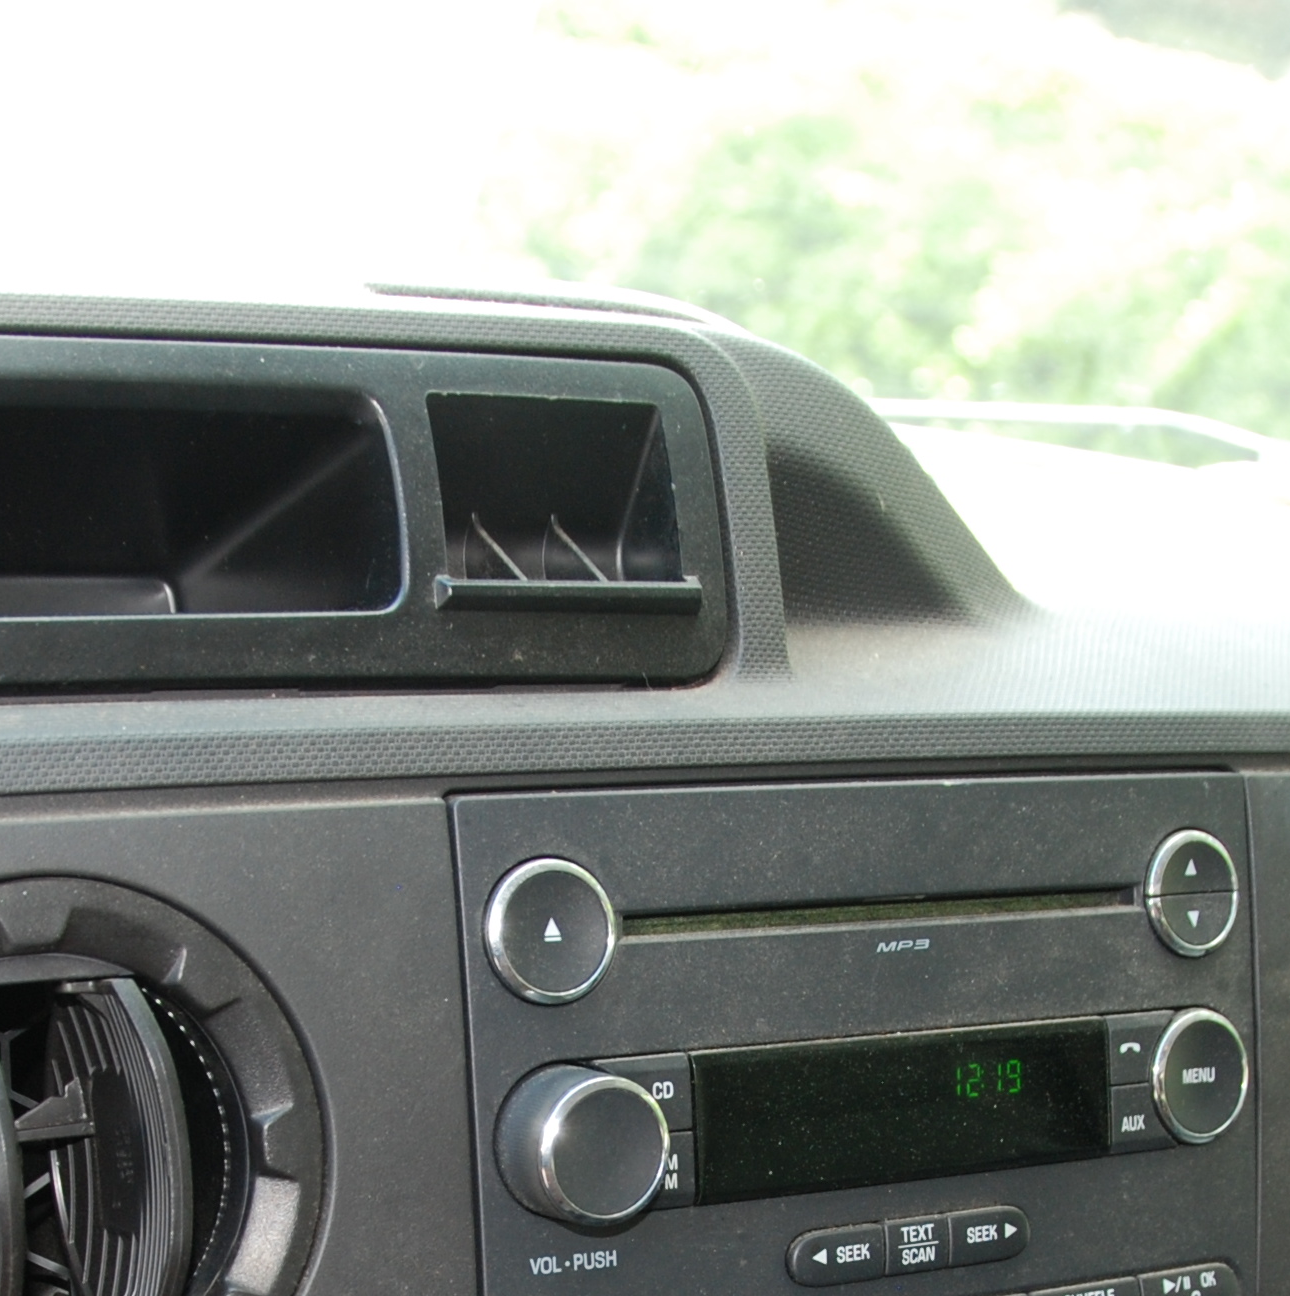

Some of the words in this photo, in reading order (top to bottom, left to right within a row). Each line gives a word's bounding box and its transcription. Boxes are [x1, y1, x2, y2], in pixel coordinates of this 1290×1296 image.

[876, 938, 931, 953] MP3
[1182, 1066, 1216, 1085] MENU
[652, 1081, 675, 1100] CD
[1121, 1114, 1146, 1133] AUX
[900, 1223, 935, 1243] TEXT
[966, 1224, 998, 1244] SEEK
[529, 1255, 562, 1275] VOL
[573, 1249, 618, 1271] PUSH
[836, 1243, 871, 1264] SEEK
[901, 1245, 936, 1266] SCAN
[1200, 1270, 1217, 1288] OK
